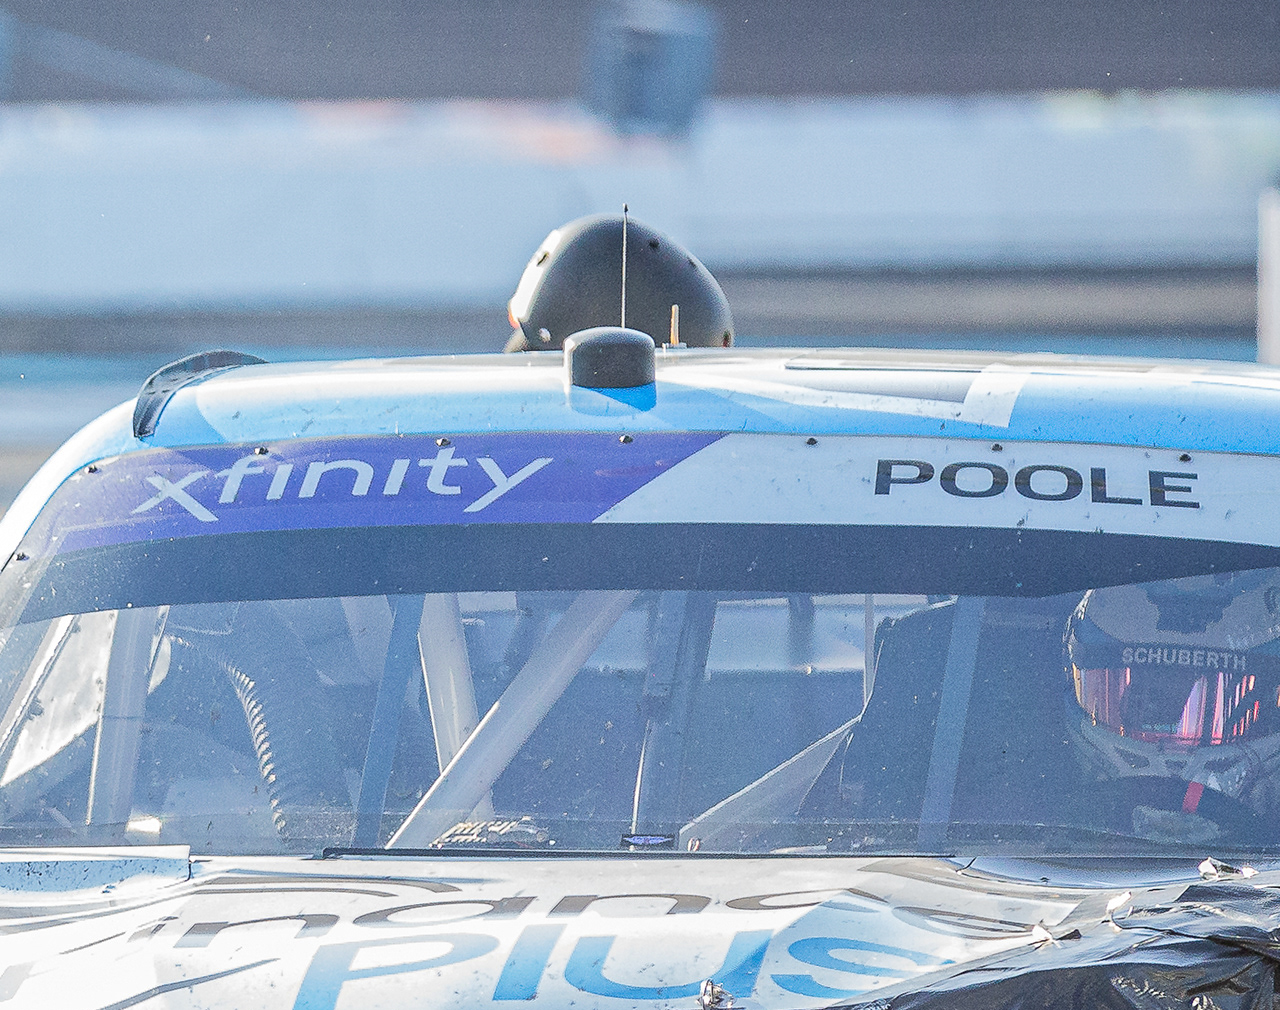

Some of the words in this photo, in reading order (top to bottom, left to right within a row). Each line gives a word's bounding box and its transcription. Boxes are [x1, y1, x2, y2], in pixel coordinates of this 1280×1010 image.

[130, 446, 553, 523] xfinity
[874, 459, 1201, 509] POOLE
[1122, 647, 1246, 670] SCHUBERTH
